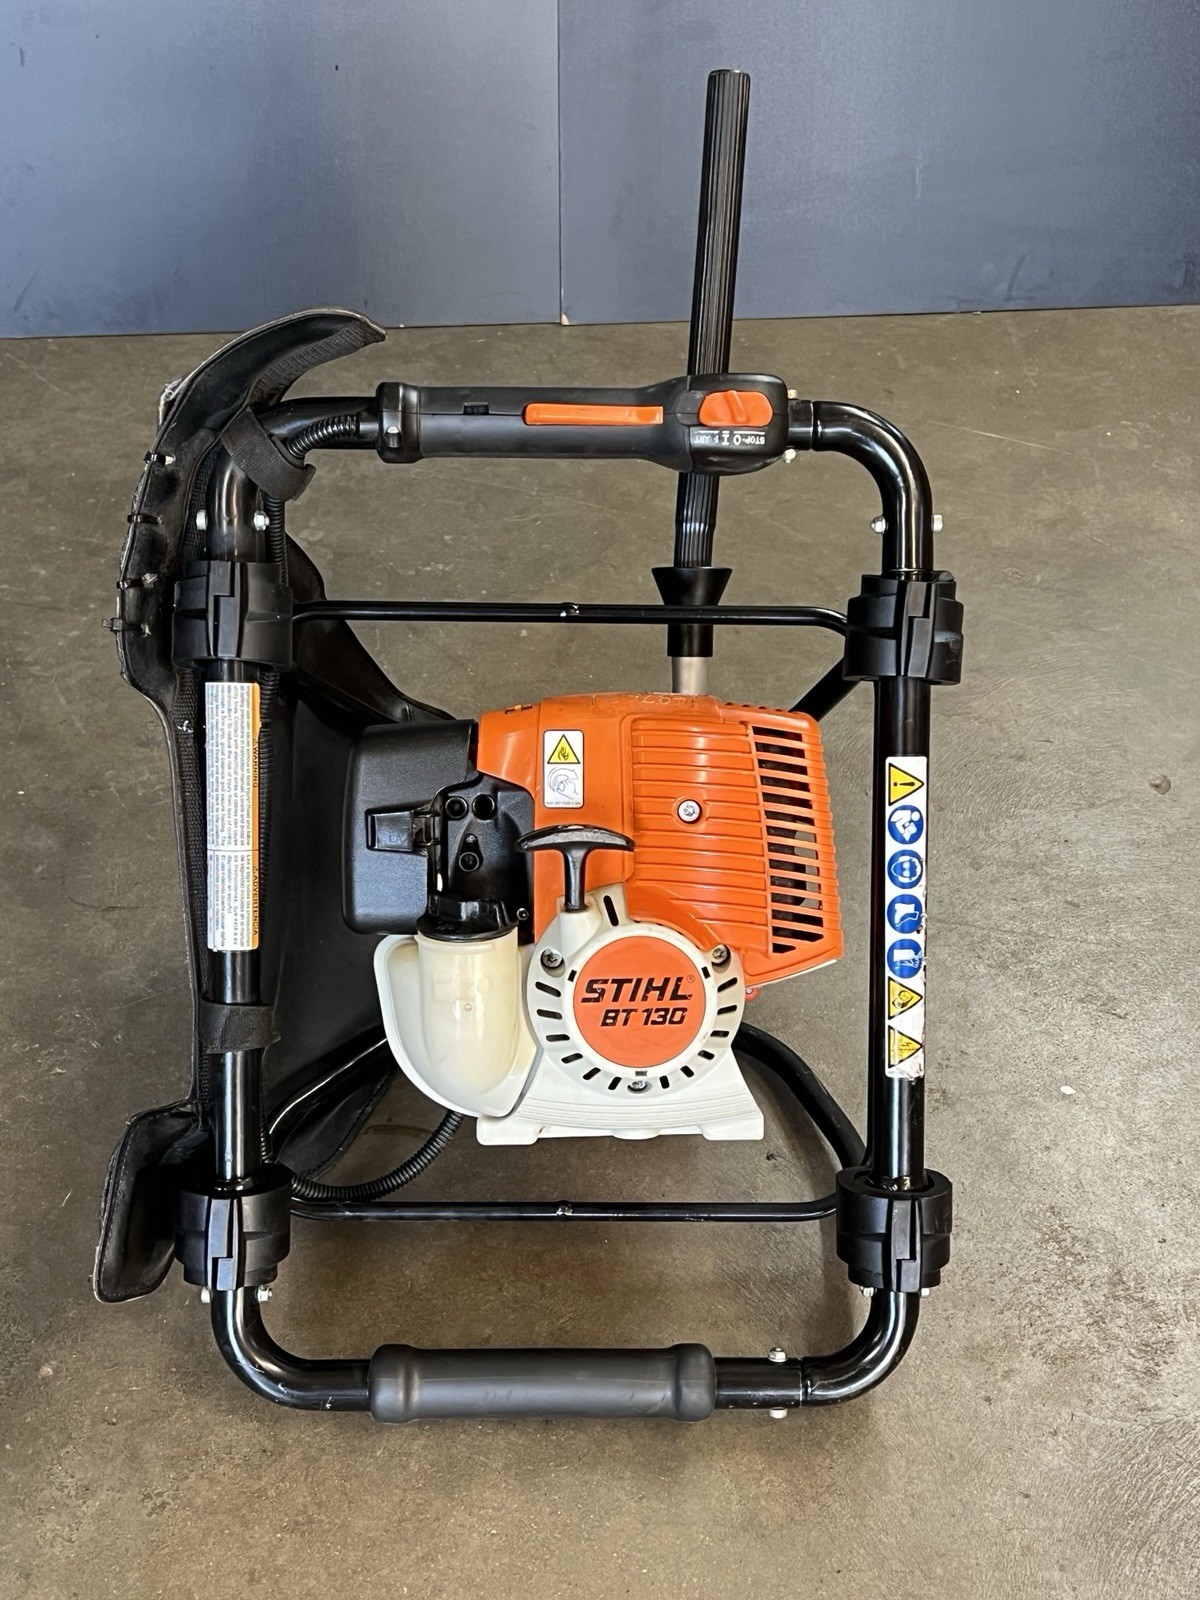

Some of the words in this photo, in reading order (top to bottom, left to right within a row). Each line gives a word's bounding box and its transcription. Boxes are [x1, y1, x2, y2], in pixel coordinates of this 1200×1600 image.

[581, 976, 692, 1003] STIHL
[600, 1008, 638, 1027] BT
[641, 1007, 688, 1026] 130
